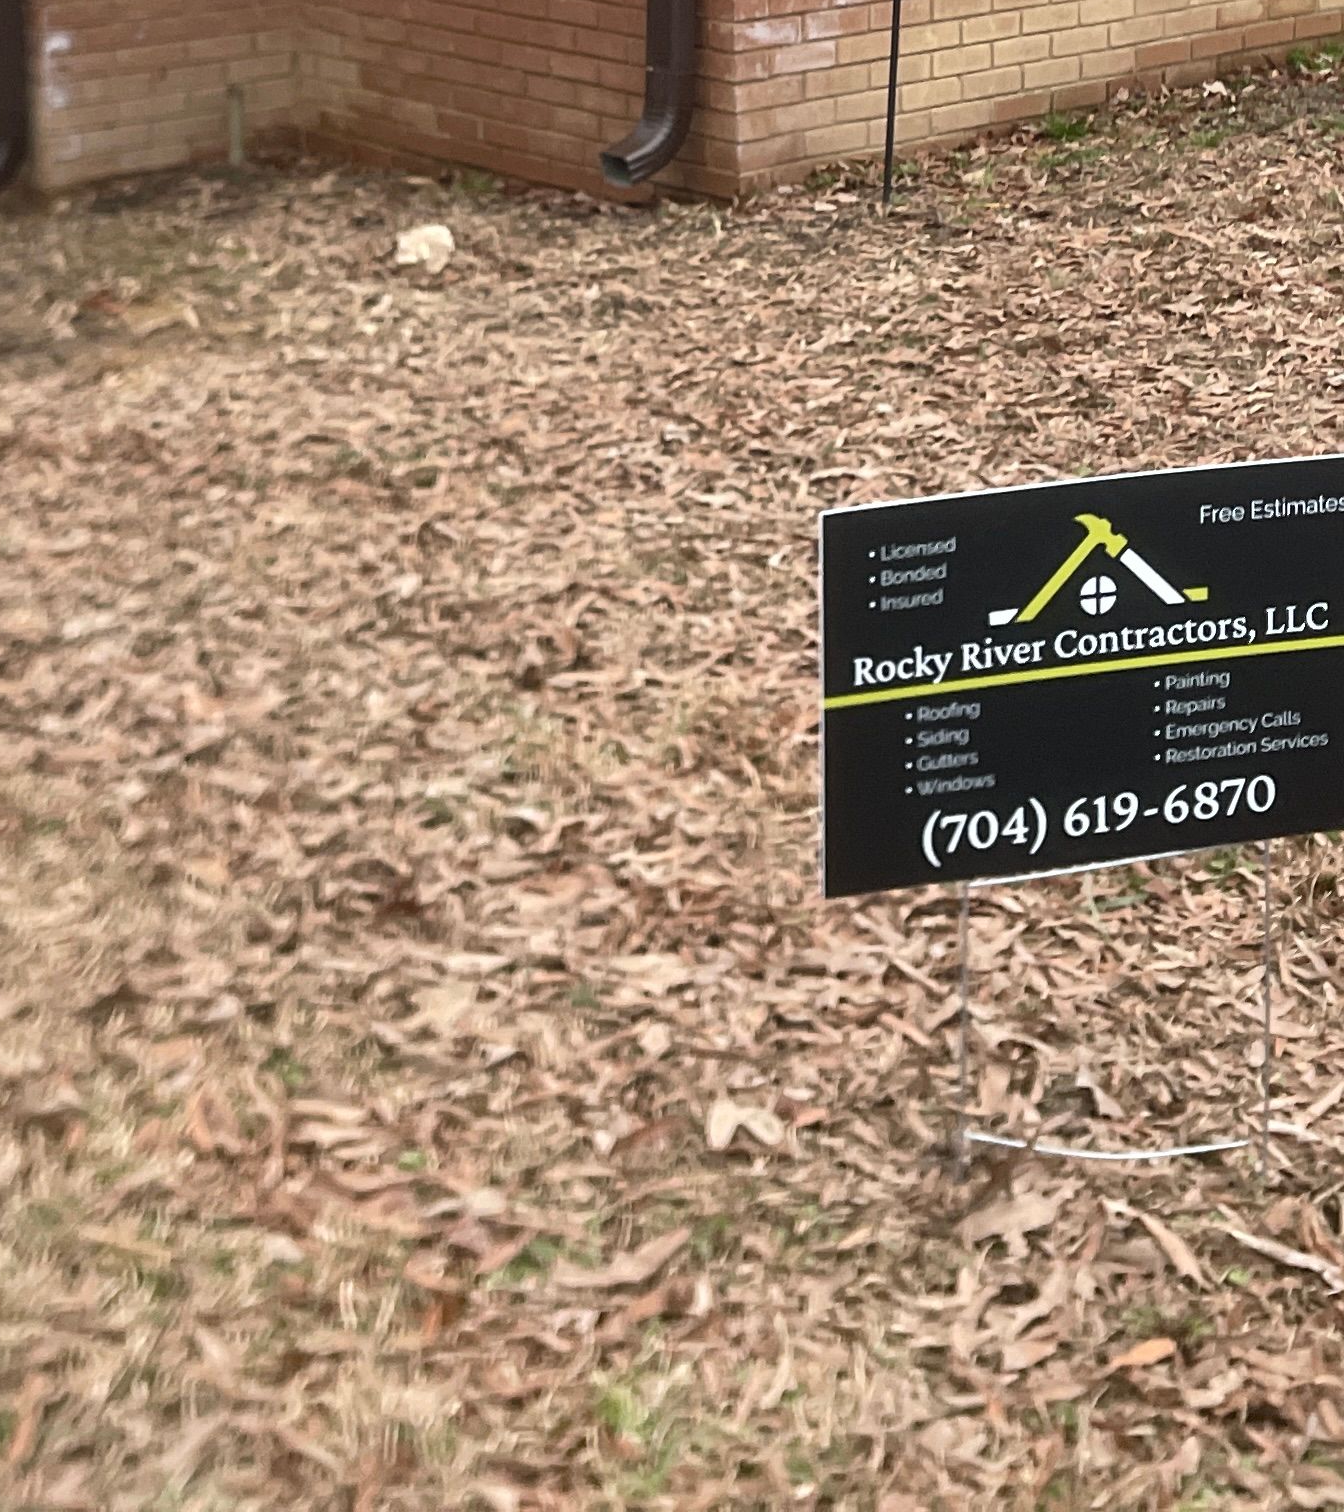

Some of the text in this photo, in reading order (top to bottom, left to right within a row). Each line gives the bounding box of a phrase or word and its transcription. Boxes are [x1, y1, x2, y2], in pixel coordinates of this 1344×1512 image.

[1199, 503, 1246, 525] Free
[880, 536, 957, 562] Licensed
[880, 562, 948, 587] Bonded
[880, 588, 944, 612] Insured
[853, 601, 1329, 687] Rocky River Contractors, LLC
[1164, 670, 1231, 691] Painting
[917, 701, 981, 723] Roofing
[1164, 696, 1227, 716] Repairs
[1164, 710, 1302, 740] Emergency Calls
[917, 728, 970, 748] Siding
[1164, 732, 1330, 764] Restoration Services
[916, 751, 979, 772] Gutters
[916, 773, 996, 796] Windows
[921, 773, 1277, 869] (704) 619-6870
